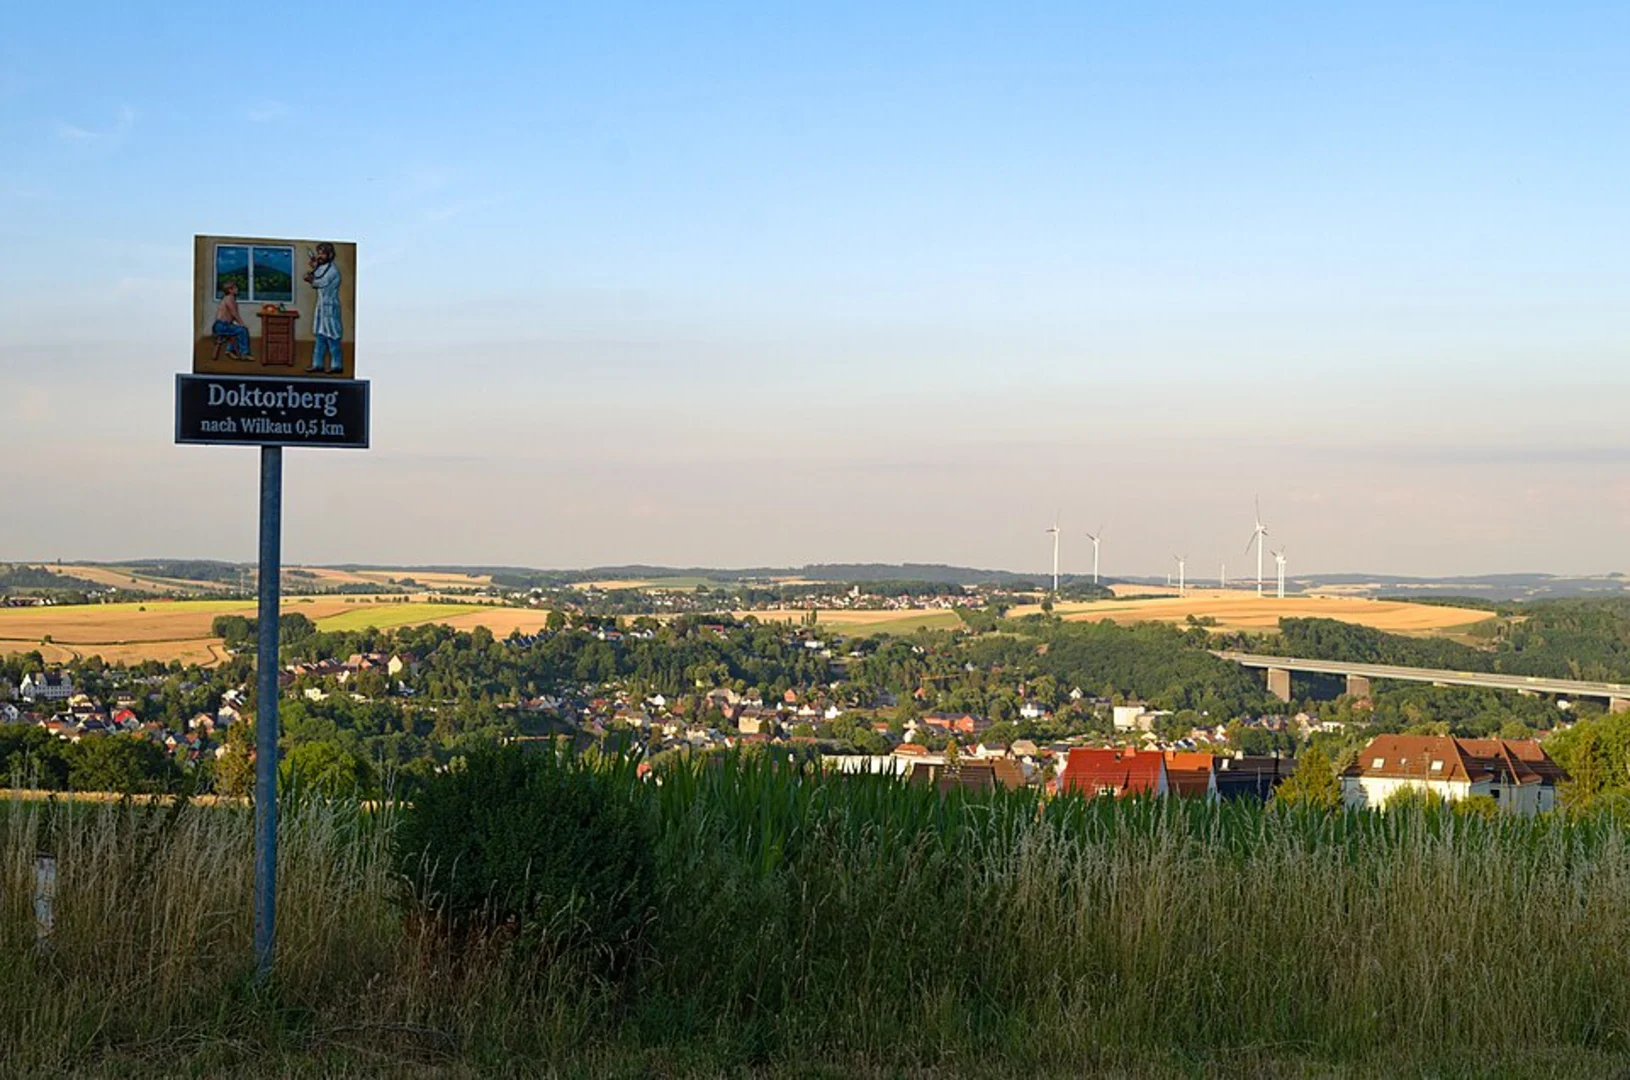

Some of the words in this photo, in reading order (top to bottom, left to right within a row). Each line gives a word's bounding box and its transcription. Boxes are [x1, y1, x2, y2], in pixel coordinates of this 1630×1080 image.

[208, 383, 338, 416] Doktorberg
[201, 417, 236, 432] nach
[241, 417, 292, 434] Wilkau
[296, 419, 318, 438] 0,5
[321, 420, 345, 436] km
